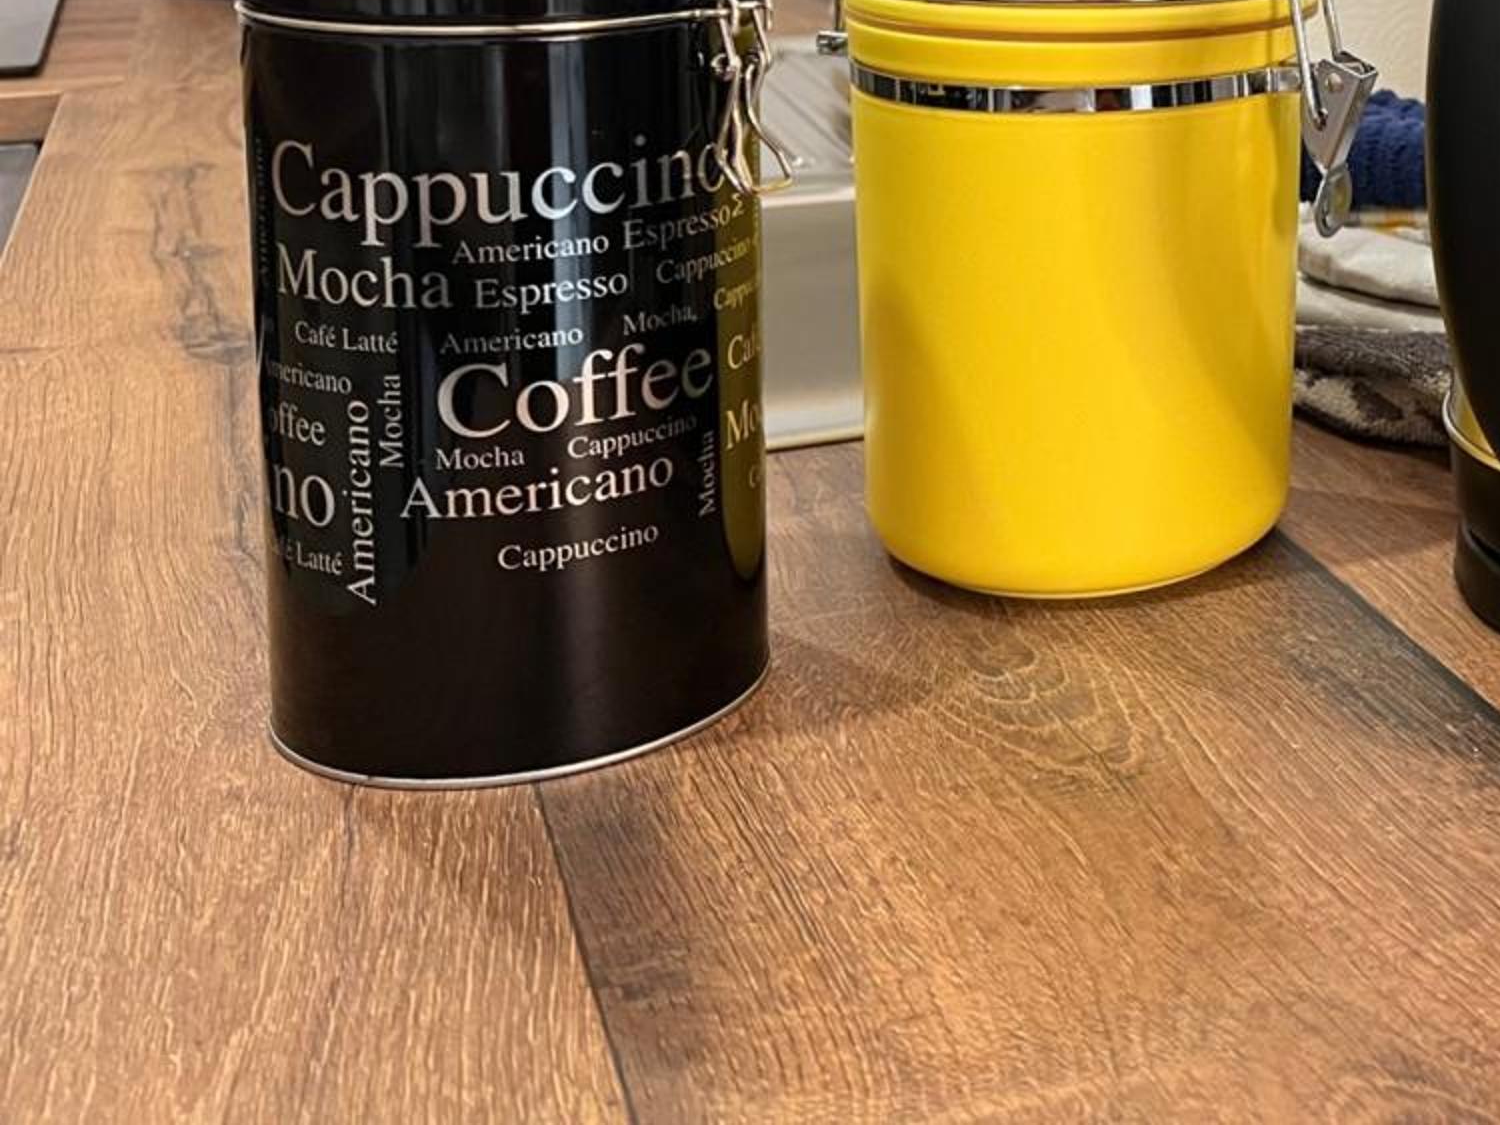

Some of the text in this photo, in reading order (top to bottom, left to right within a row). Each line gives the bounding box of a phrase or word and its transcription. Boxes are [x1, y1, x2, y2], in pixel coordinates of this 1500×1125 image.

[271, 133, 726, 249] Cappuccino
[451, 234, 609, 265] Americano
[622, 205, 731, 252] Espresso
[275, 241, 453, 310] Mocha
[474, 272, 629, 316] Espresso
[294, 320, 399, 354] Café Latté
[439, 326, 584, 355] Americano
[436, 342, 714, 439] Coffee
[376, 374, 405, 468] Mocha
[566, 413, 698, 460] Cappuccino
[434, 446, 526, 472] Mocha
[696, 429, 717, 518] Mocha
[341, 399, 377, 607] Americano
[399, 456, 674, 519] Americano
[295, 539, 343, 576] Latté
[496, 524, 660, 572] Cappuccino
